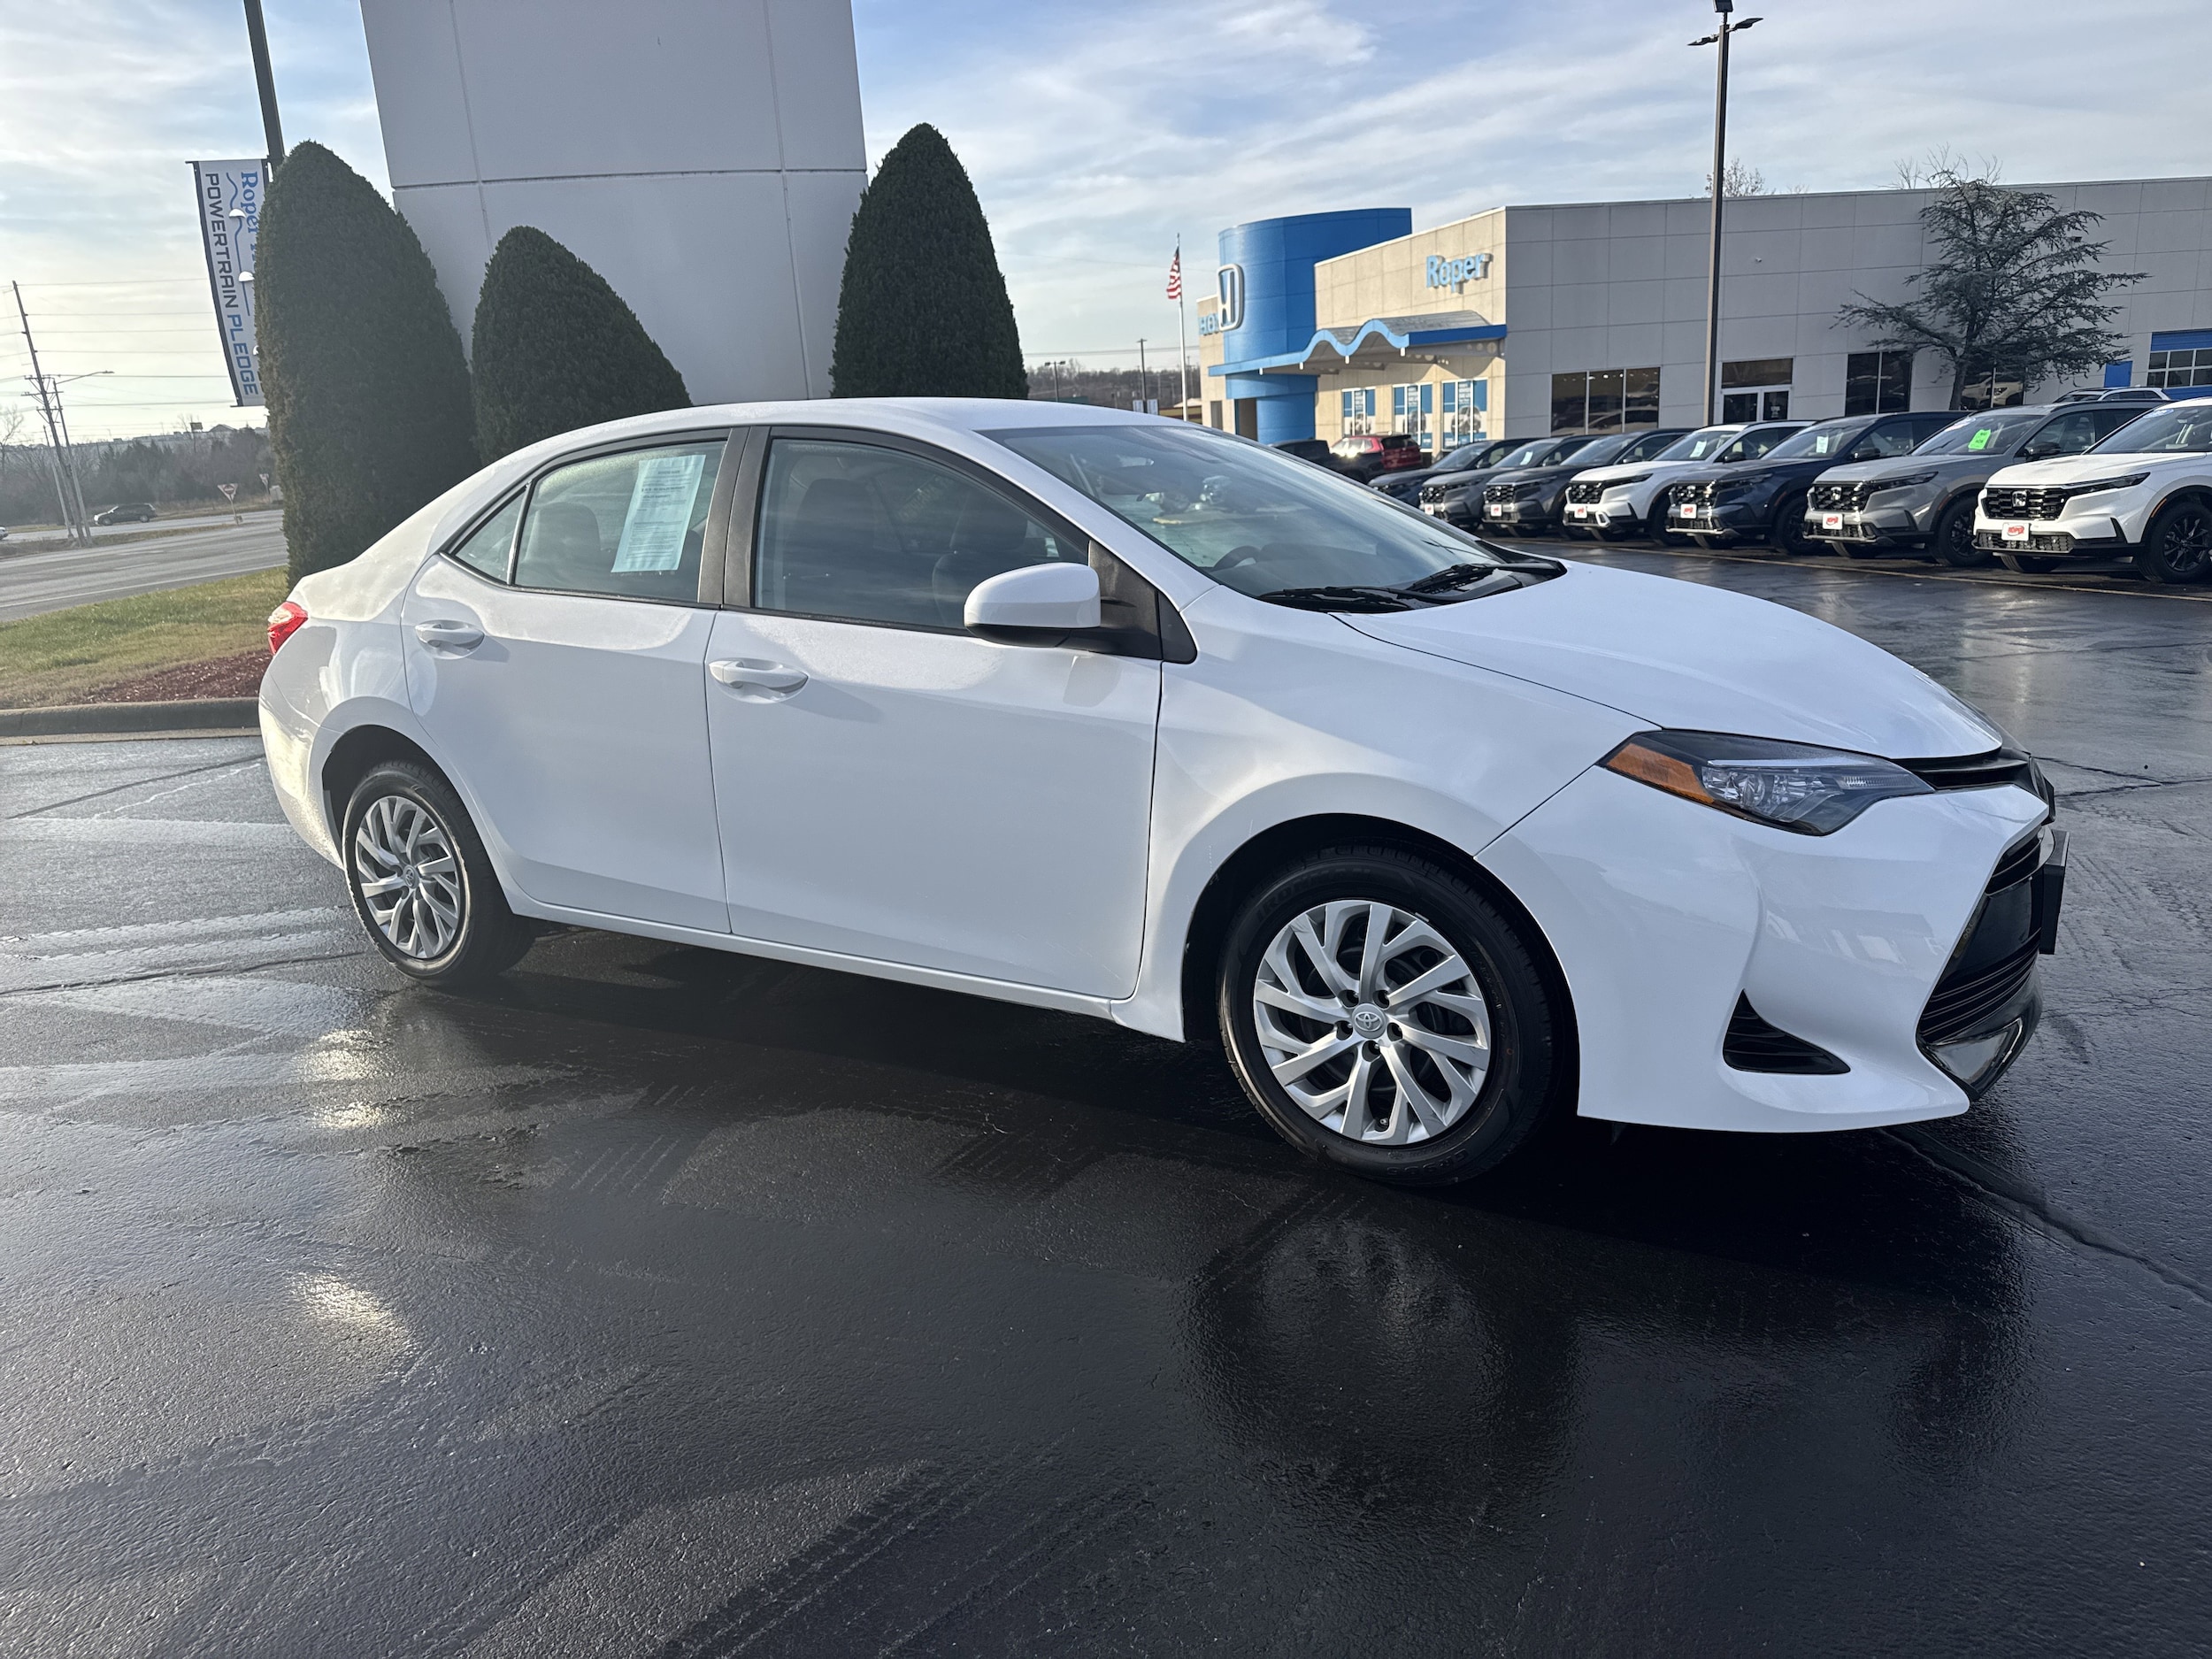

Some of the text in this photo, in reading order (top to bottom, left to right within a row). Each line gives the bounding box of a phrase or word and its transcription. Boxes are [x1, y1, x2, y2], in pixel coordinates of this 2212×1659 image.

[205, 173, 258, 396] POWERTRAIN PLEDGE
[1425, 253, 1494, 295] Roper
